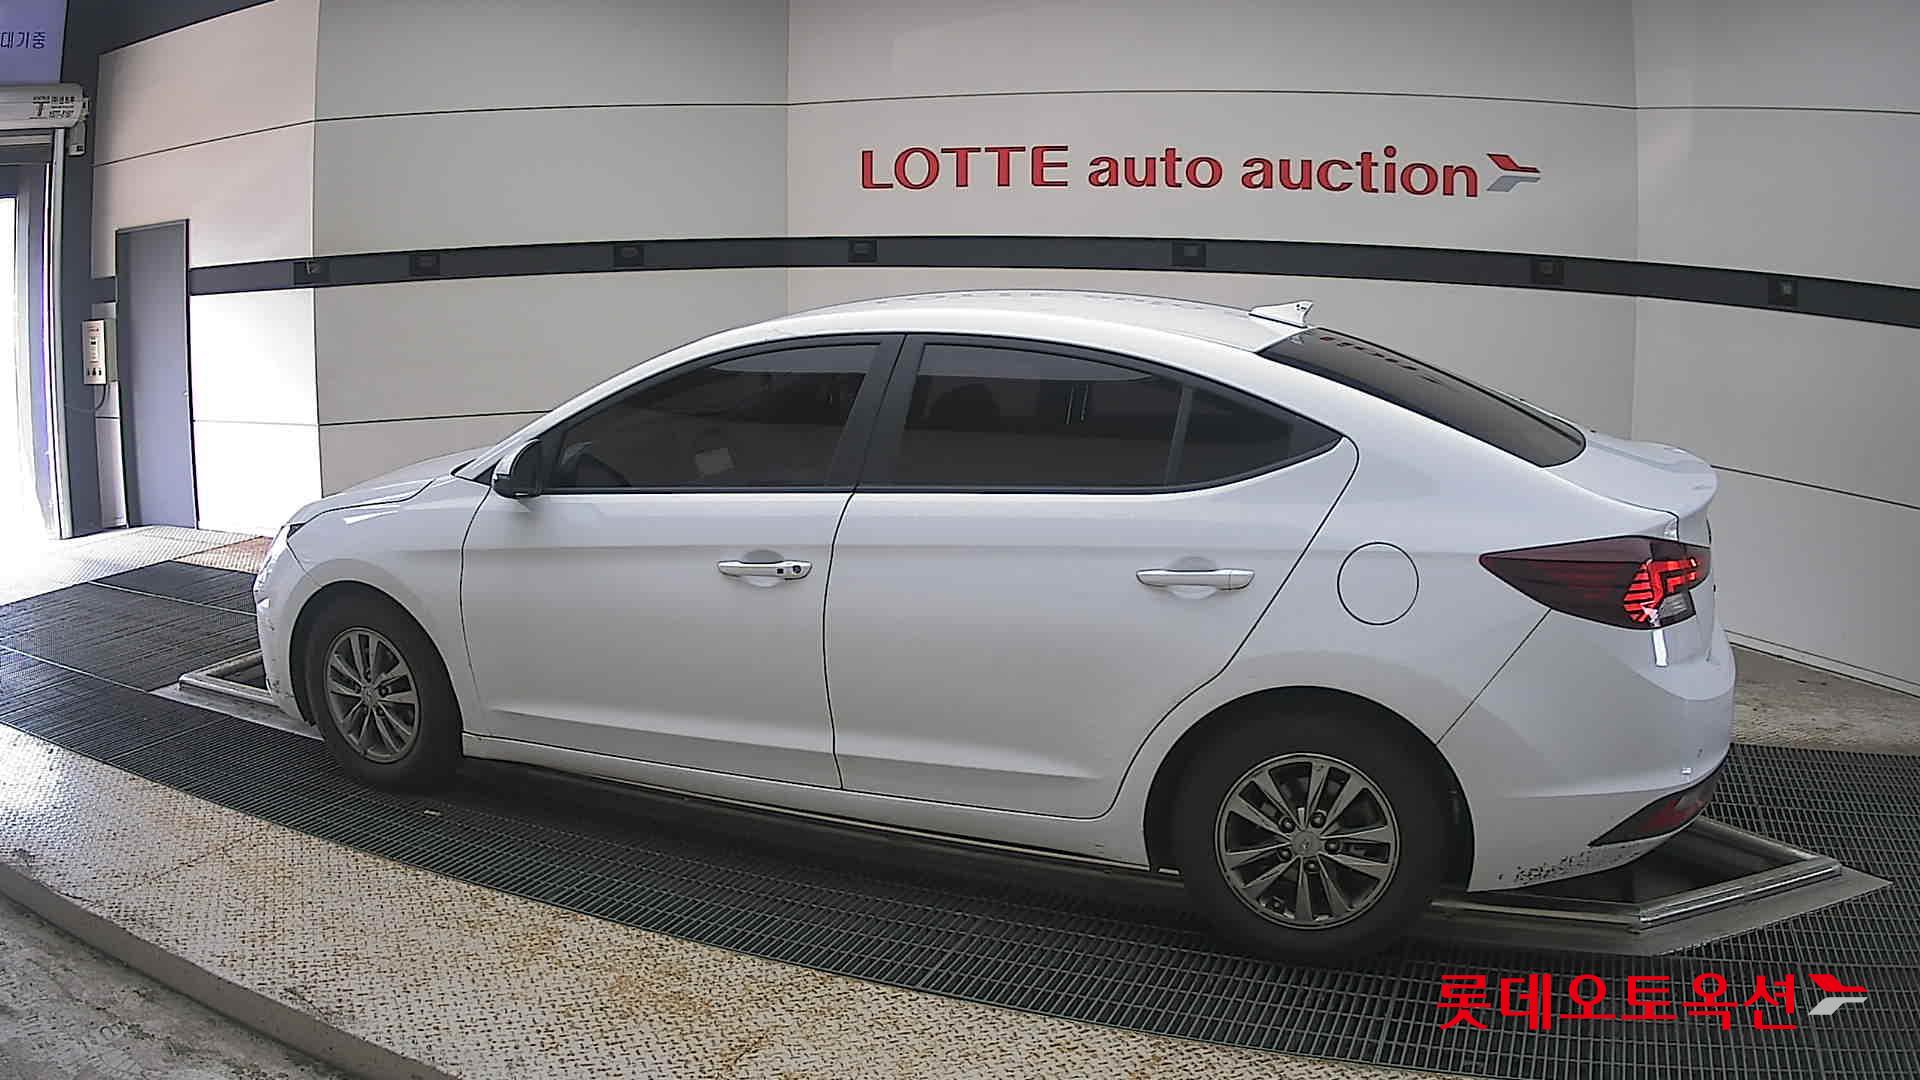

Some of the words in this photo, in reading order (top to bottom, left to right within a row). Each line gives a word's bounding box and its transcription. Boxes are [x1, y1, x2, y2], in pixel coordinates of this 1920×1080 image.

[0, 31, 47, 50] 대기중
[861, 144, 1069, 190] LOTTE
[1088, 147, 1224, 189] auto
[1240, 146, 1479, 198] auction
